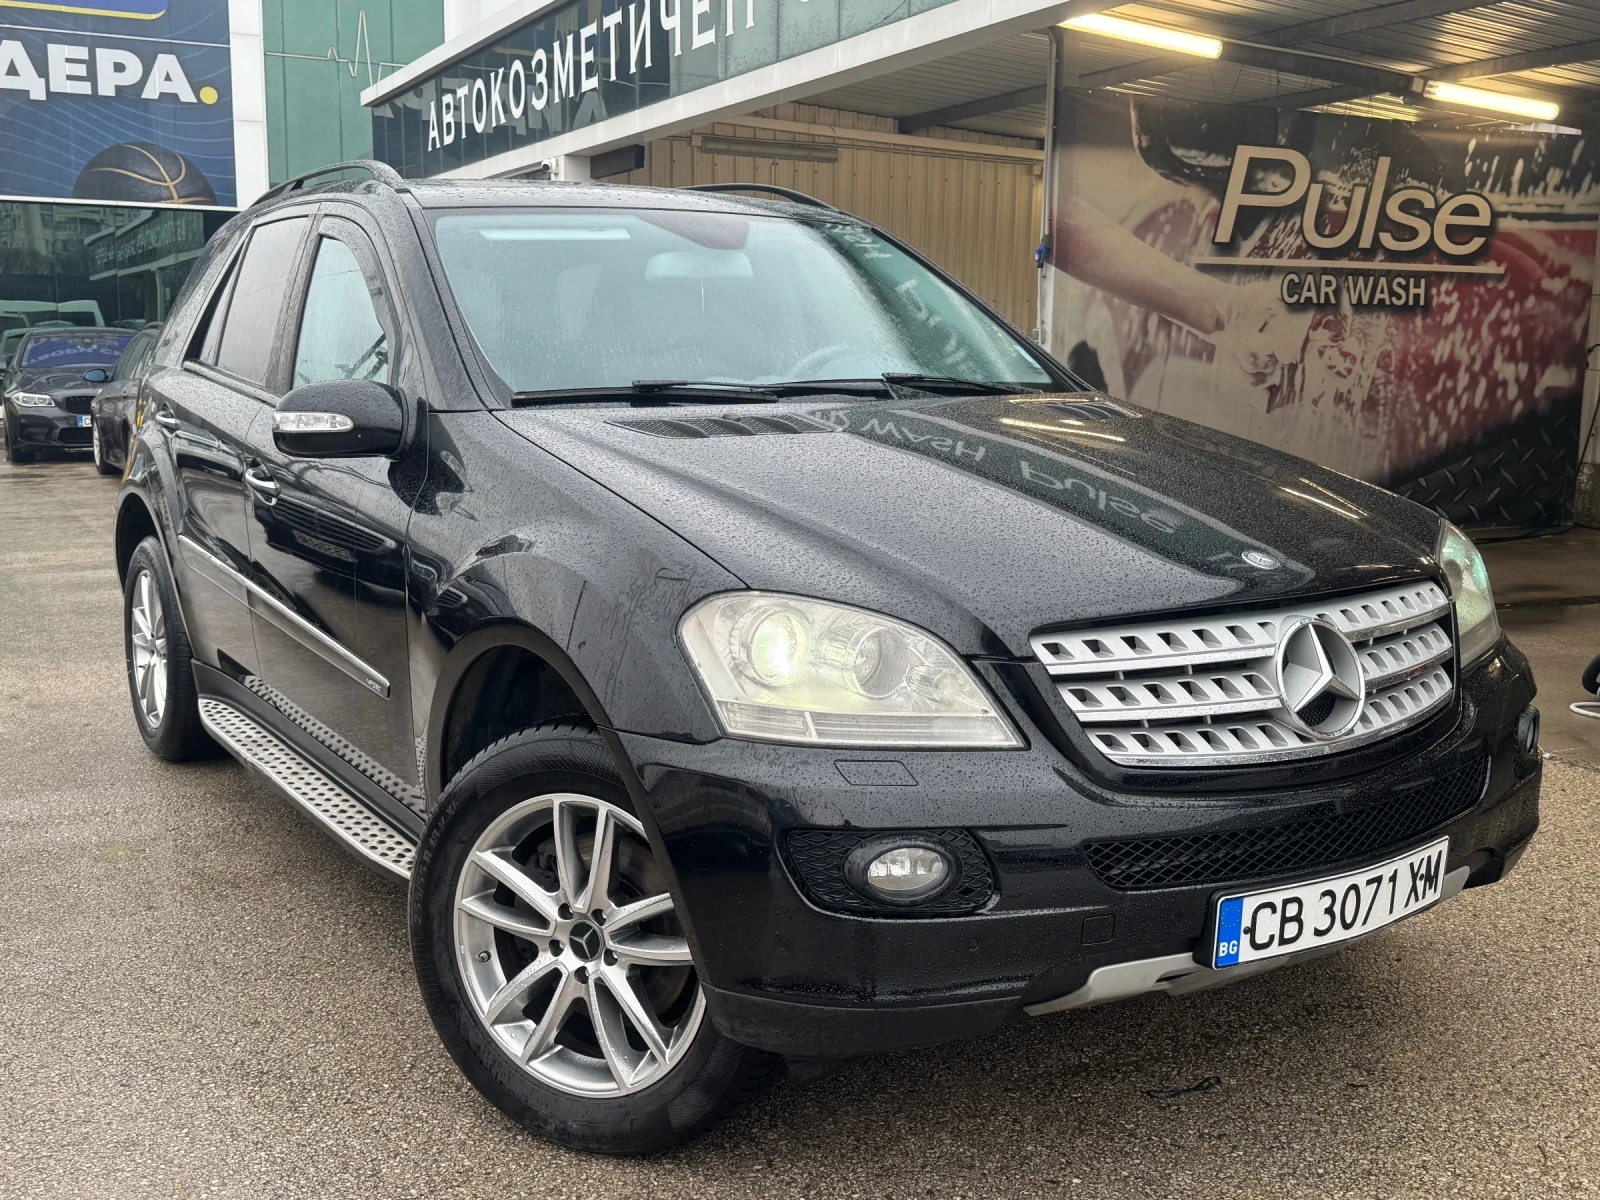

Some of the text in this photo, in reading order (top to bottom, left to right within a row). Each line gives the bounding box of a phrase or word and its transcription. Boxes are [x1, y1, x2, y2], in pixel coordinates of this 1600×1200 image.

[1212, 144, 1492, 256] Pulse
[1281, 273, 1426, 307] CAR WASH
[1249, 850, 1442, 951] CB 3071 XM
[1219, 940, 1238, 957] BG
